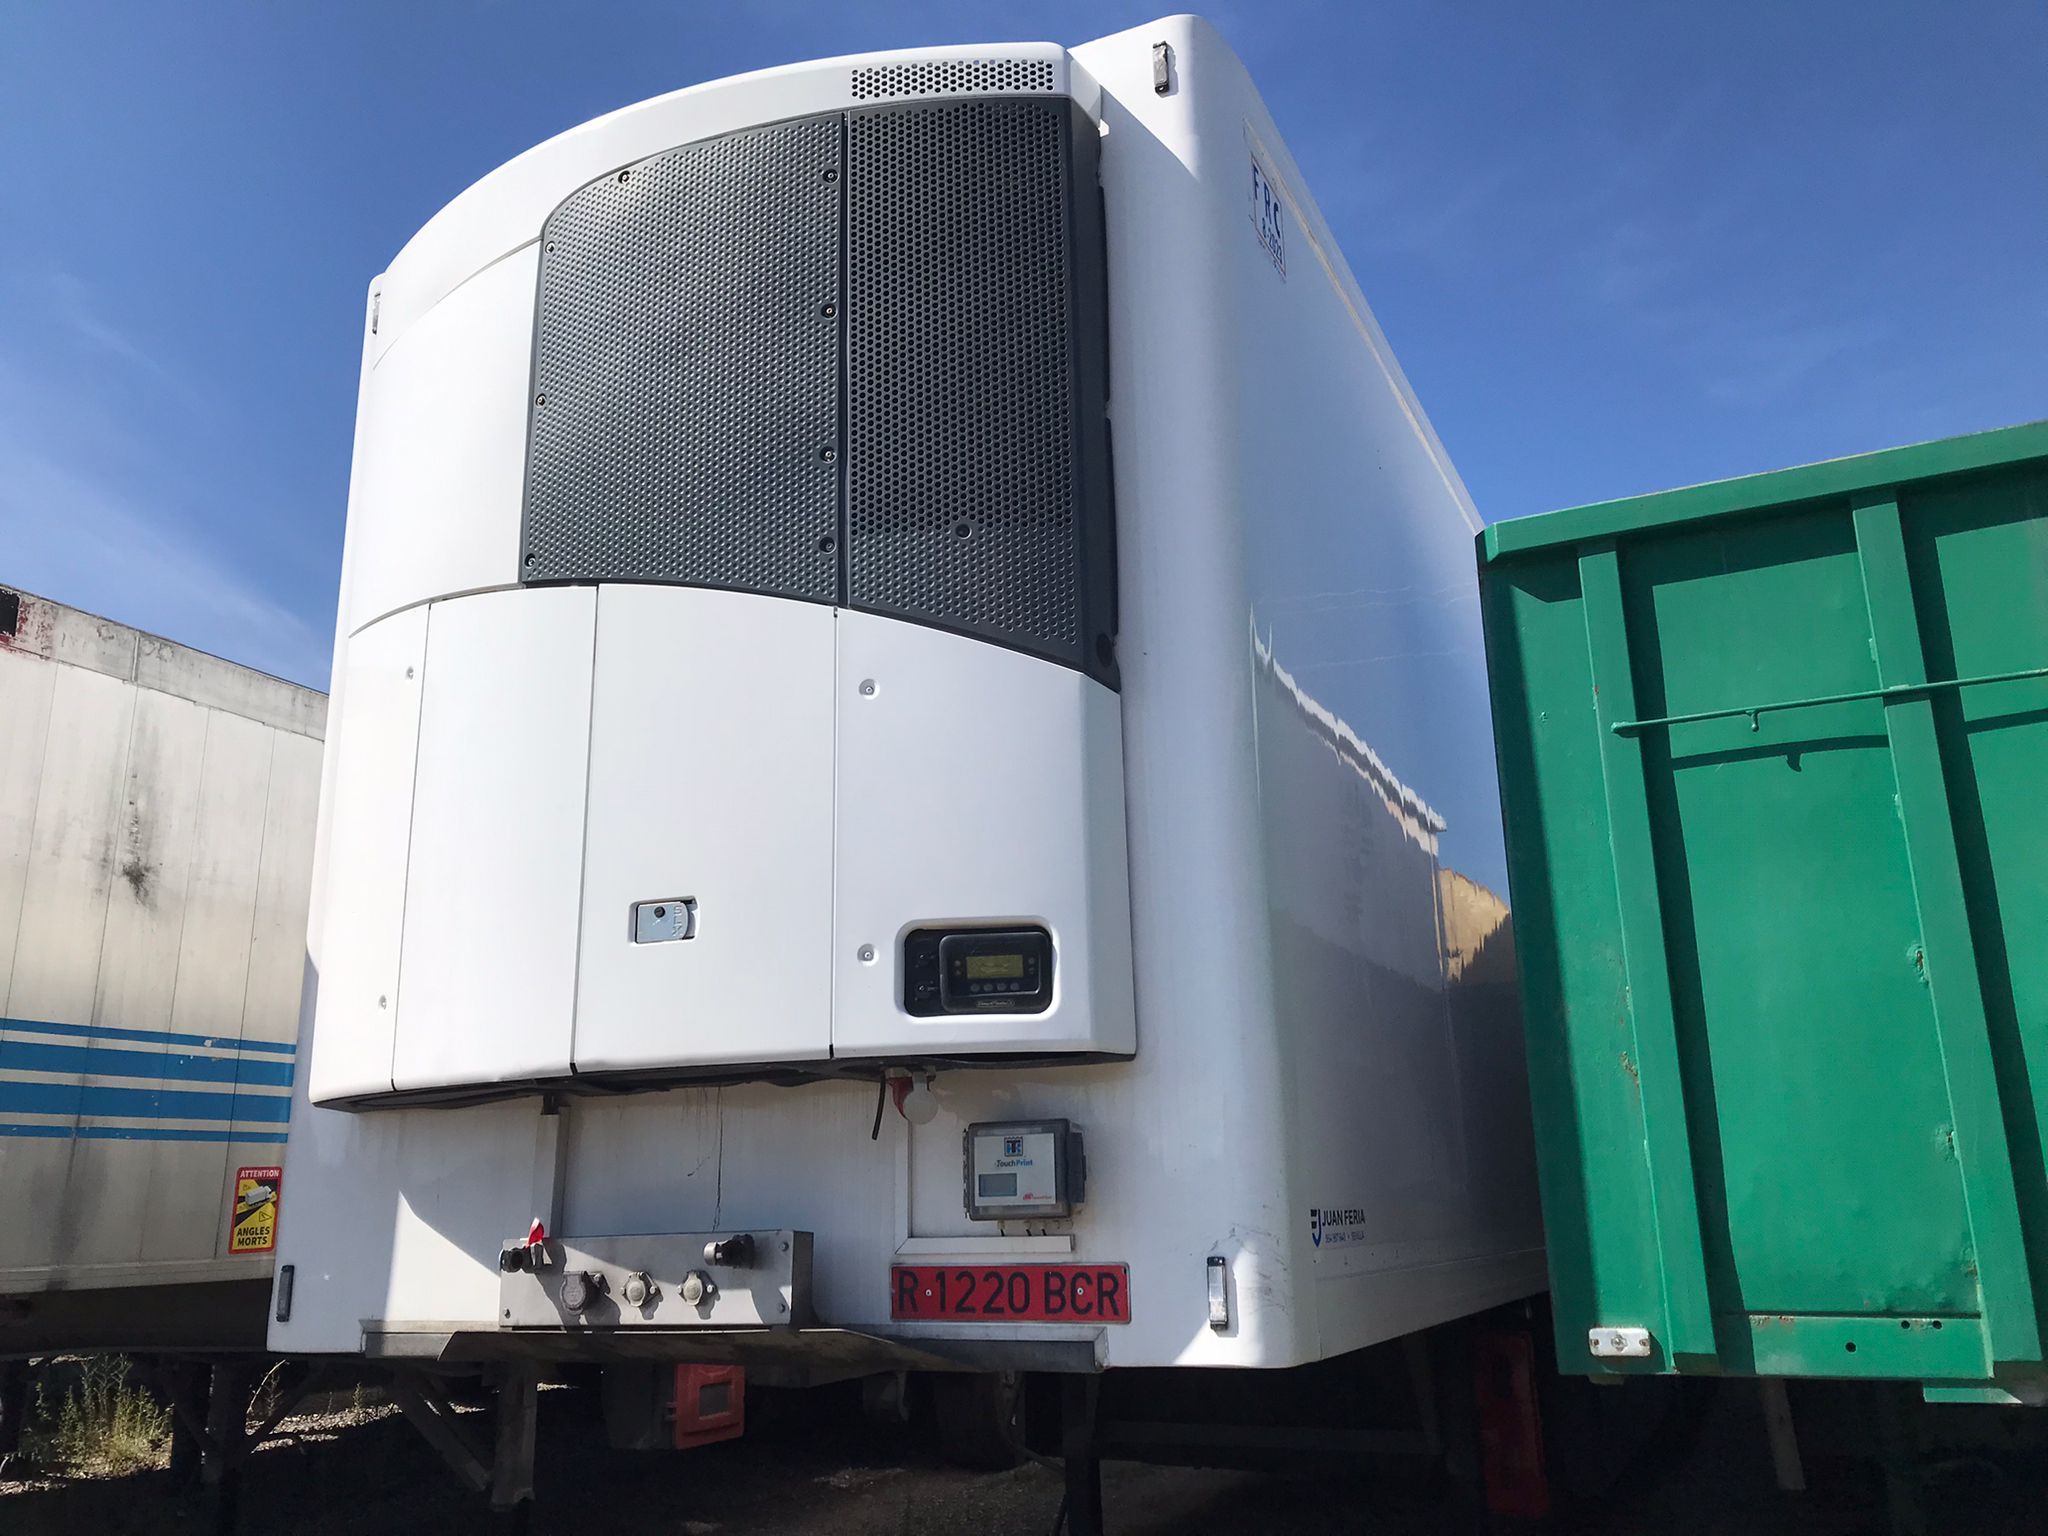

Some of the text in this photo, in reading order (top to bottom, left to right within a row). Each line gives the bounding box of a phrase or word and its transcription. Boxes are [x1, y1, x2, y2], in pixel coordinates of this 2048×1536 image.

[1252, 164, 1281, 239] FRC
[240, 1170, 280, 1178] ATTENTION
[1322, 1208, 1366, 1227] JUAN FERIA
[236, 1226, 270, 1237] ANGLES
[237, 1236, 268, 1247] MORTS
[898, 1270, 1120, 1316] R 1220 BCR
